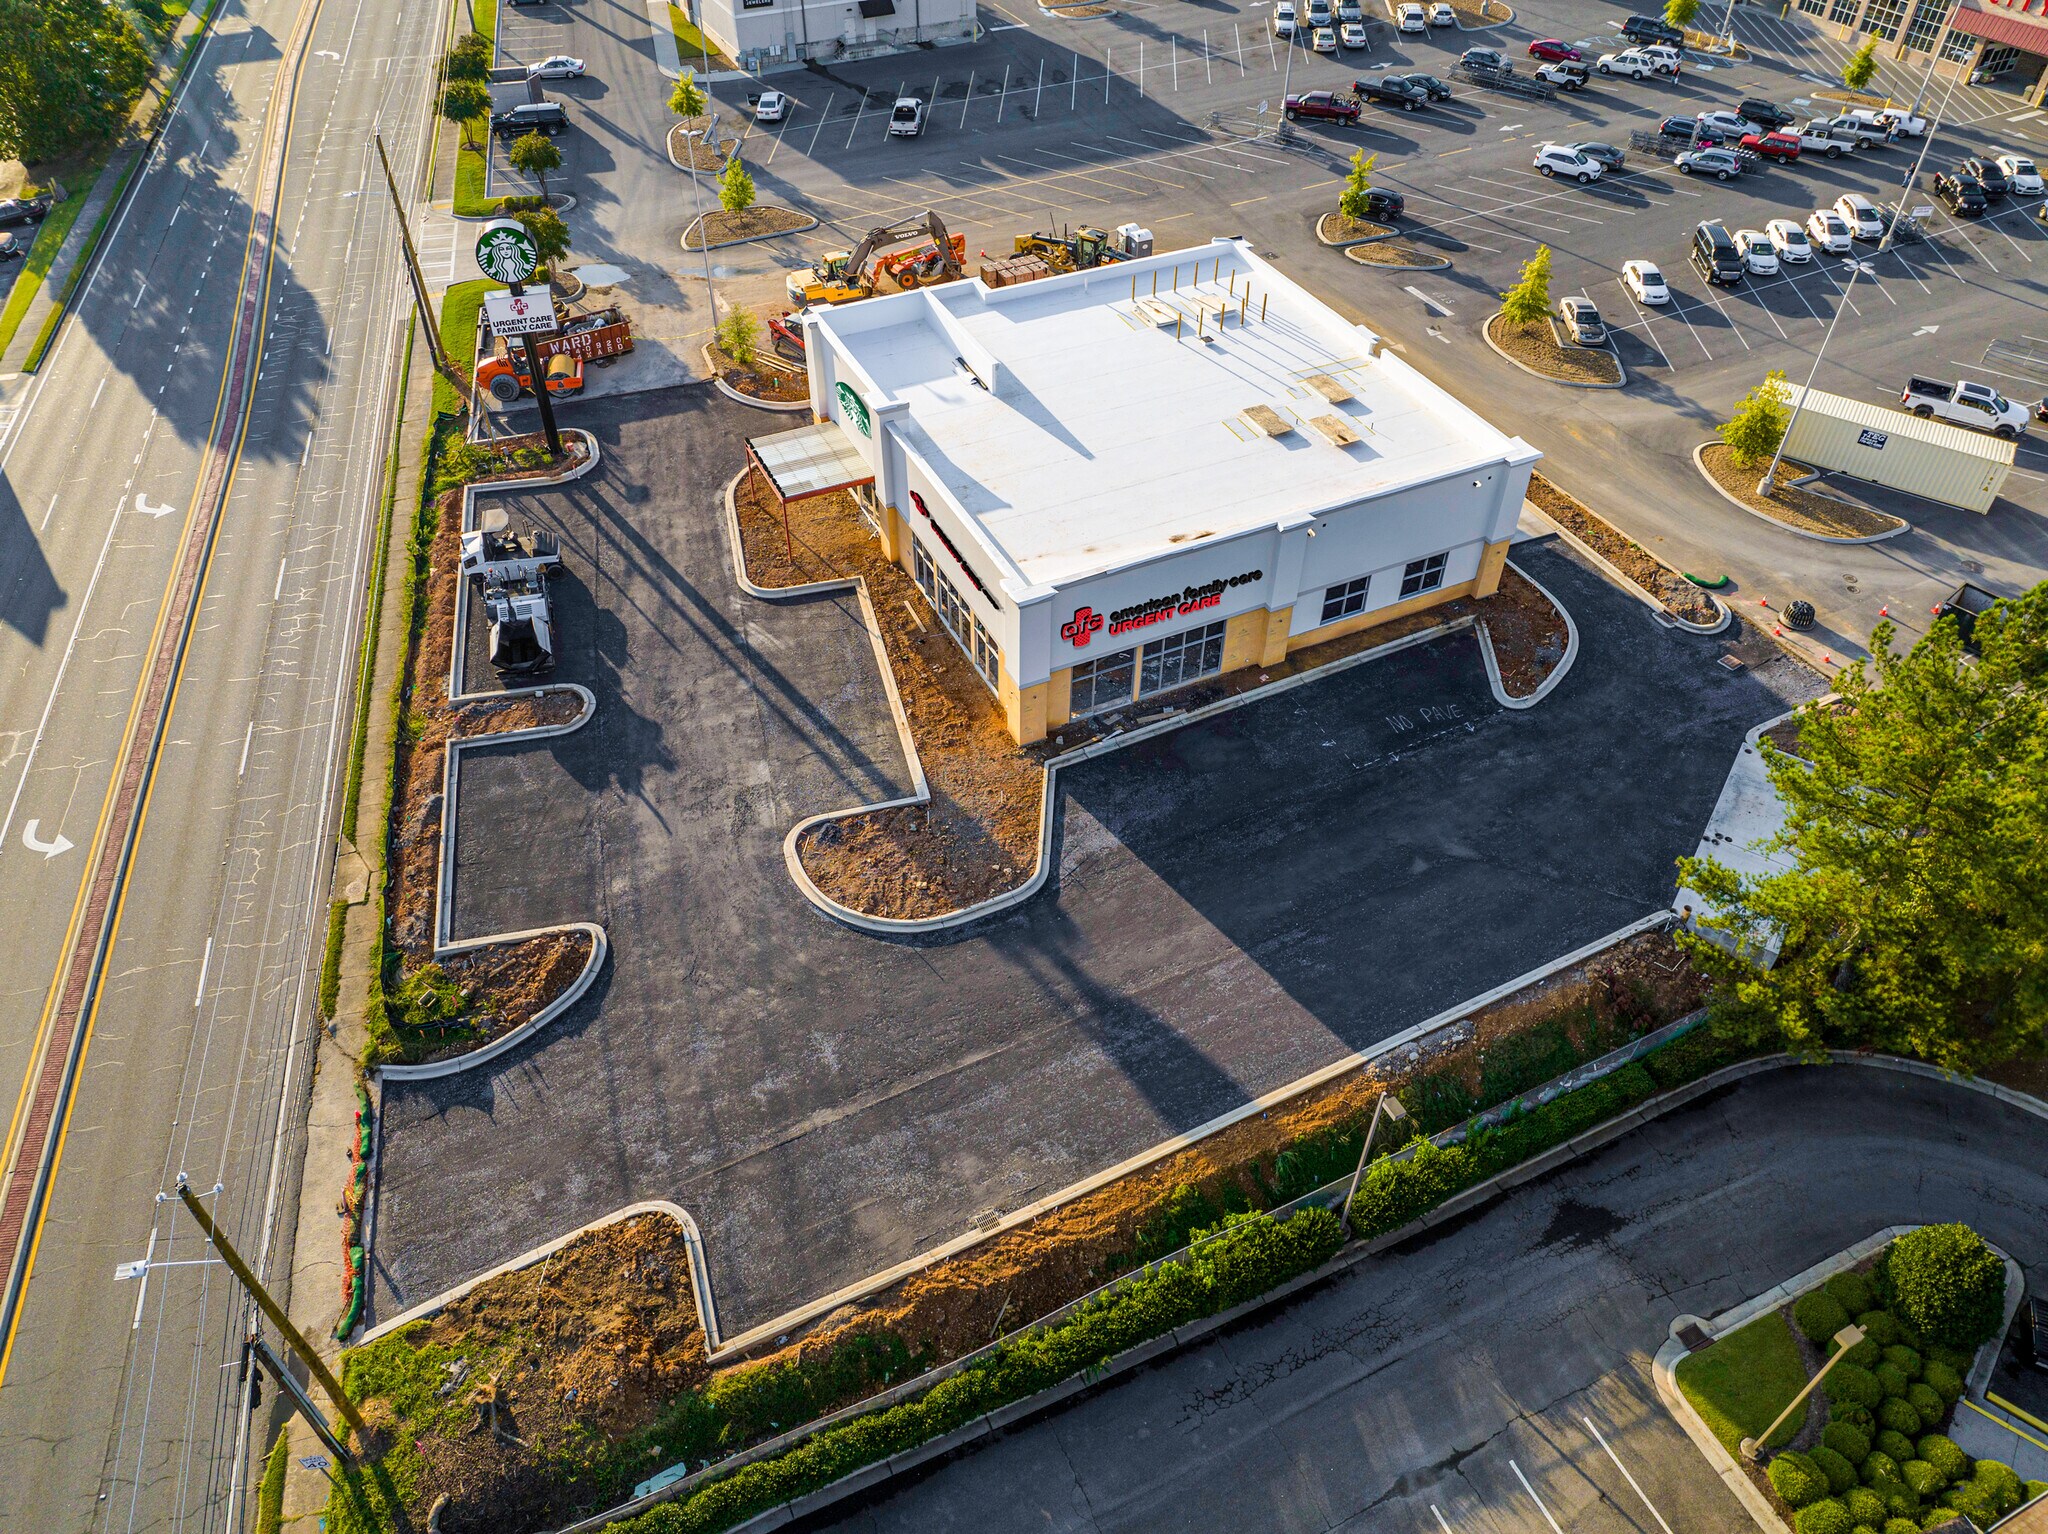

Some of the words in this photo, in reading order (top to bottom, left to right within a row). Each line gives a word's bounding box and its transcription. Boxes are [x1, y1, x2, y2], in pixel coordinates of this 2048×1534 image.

[894, 230, 919, 240] VOLVO
[493, 317, 528, 328] URGENT
[529, 314, 553, 324] CARE
[496, 325, 528, 335] FAMILY
[528, 322, 553, 331] CARE
[550, 334, 592, 354] WARD
[1867, 431, 1887, 442] TEG
[1109, 592, 1182, 623] american
[1182, 578, 1229, 601] family
[1228, 569, 1263, 588] care
[1108, 606, 1177, 637] URGENT
[1177, 593, 1222, 616] CARE
[1385, 714, 1414, 734] NO
[1419, 704, 1464, 723] PAVE
